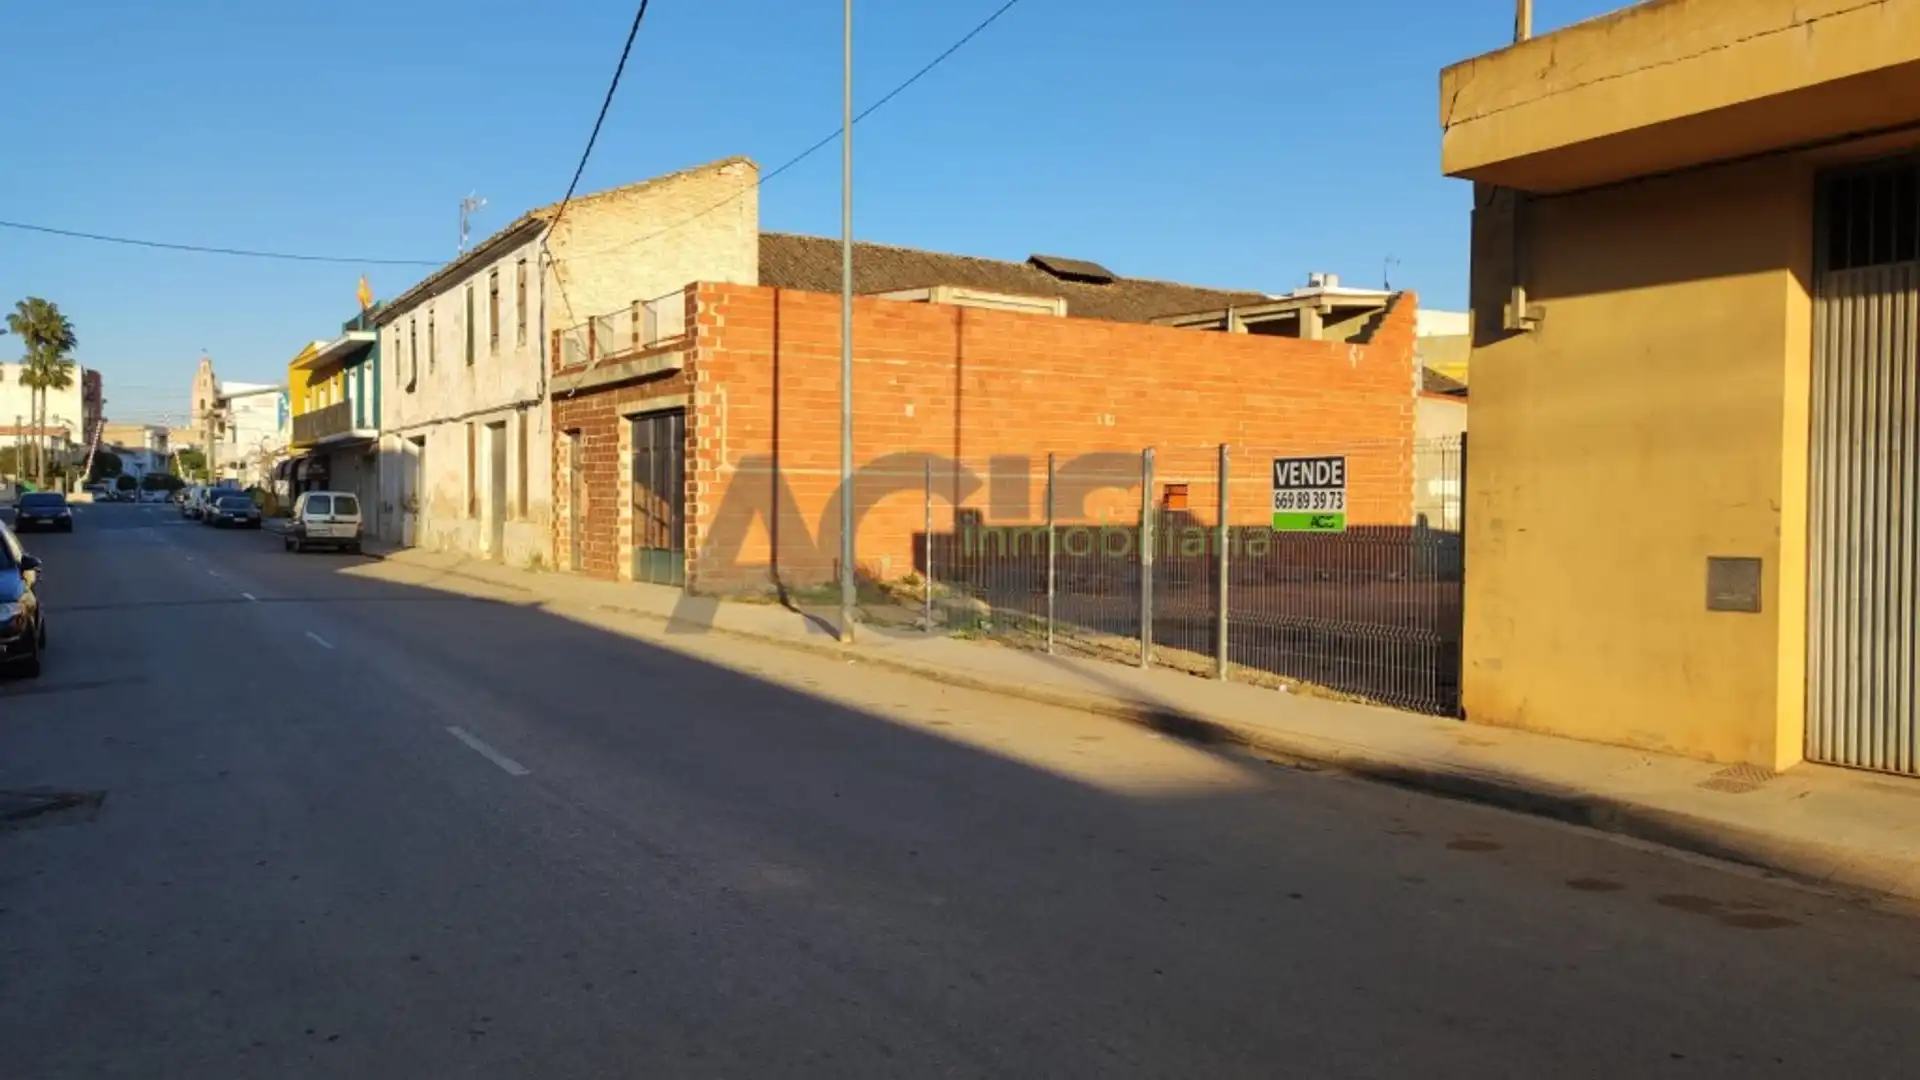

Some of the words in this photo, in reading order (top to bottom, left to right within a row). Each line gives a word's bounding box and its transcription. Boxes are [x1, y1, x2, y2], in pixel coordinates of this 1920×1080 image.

[1275, 460, 1342, 486] VENDE
[1275, 491, 1294, 509] 669
[1296, 491, 1310, 509] 89
[1312, 491, 1327, 509] 39
[1329, 491, 1343, 509] 73
